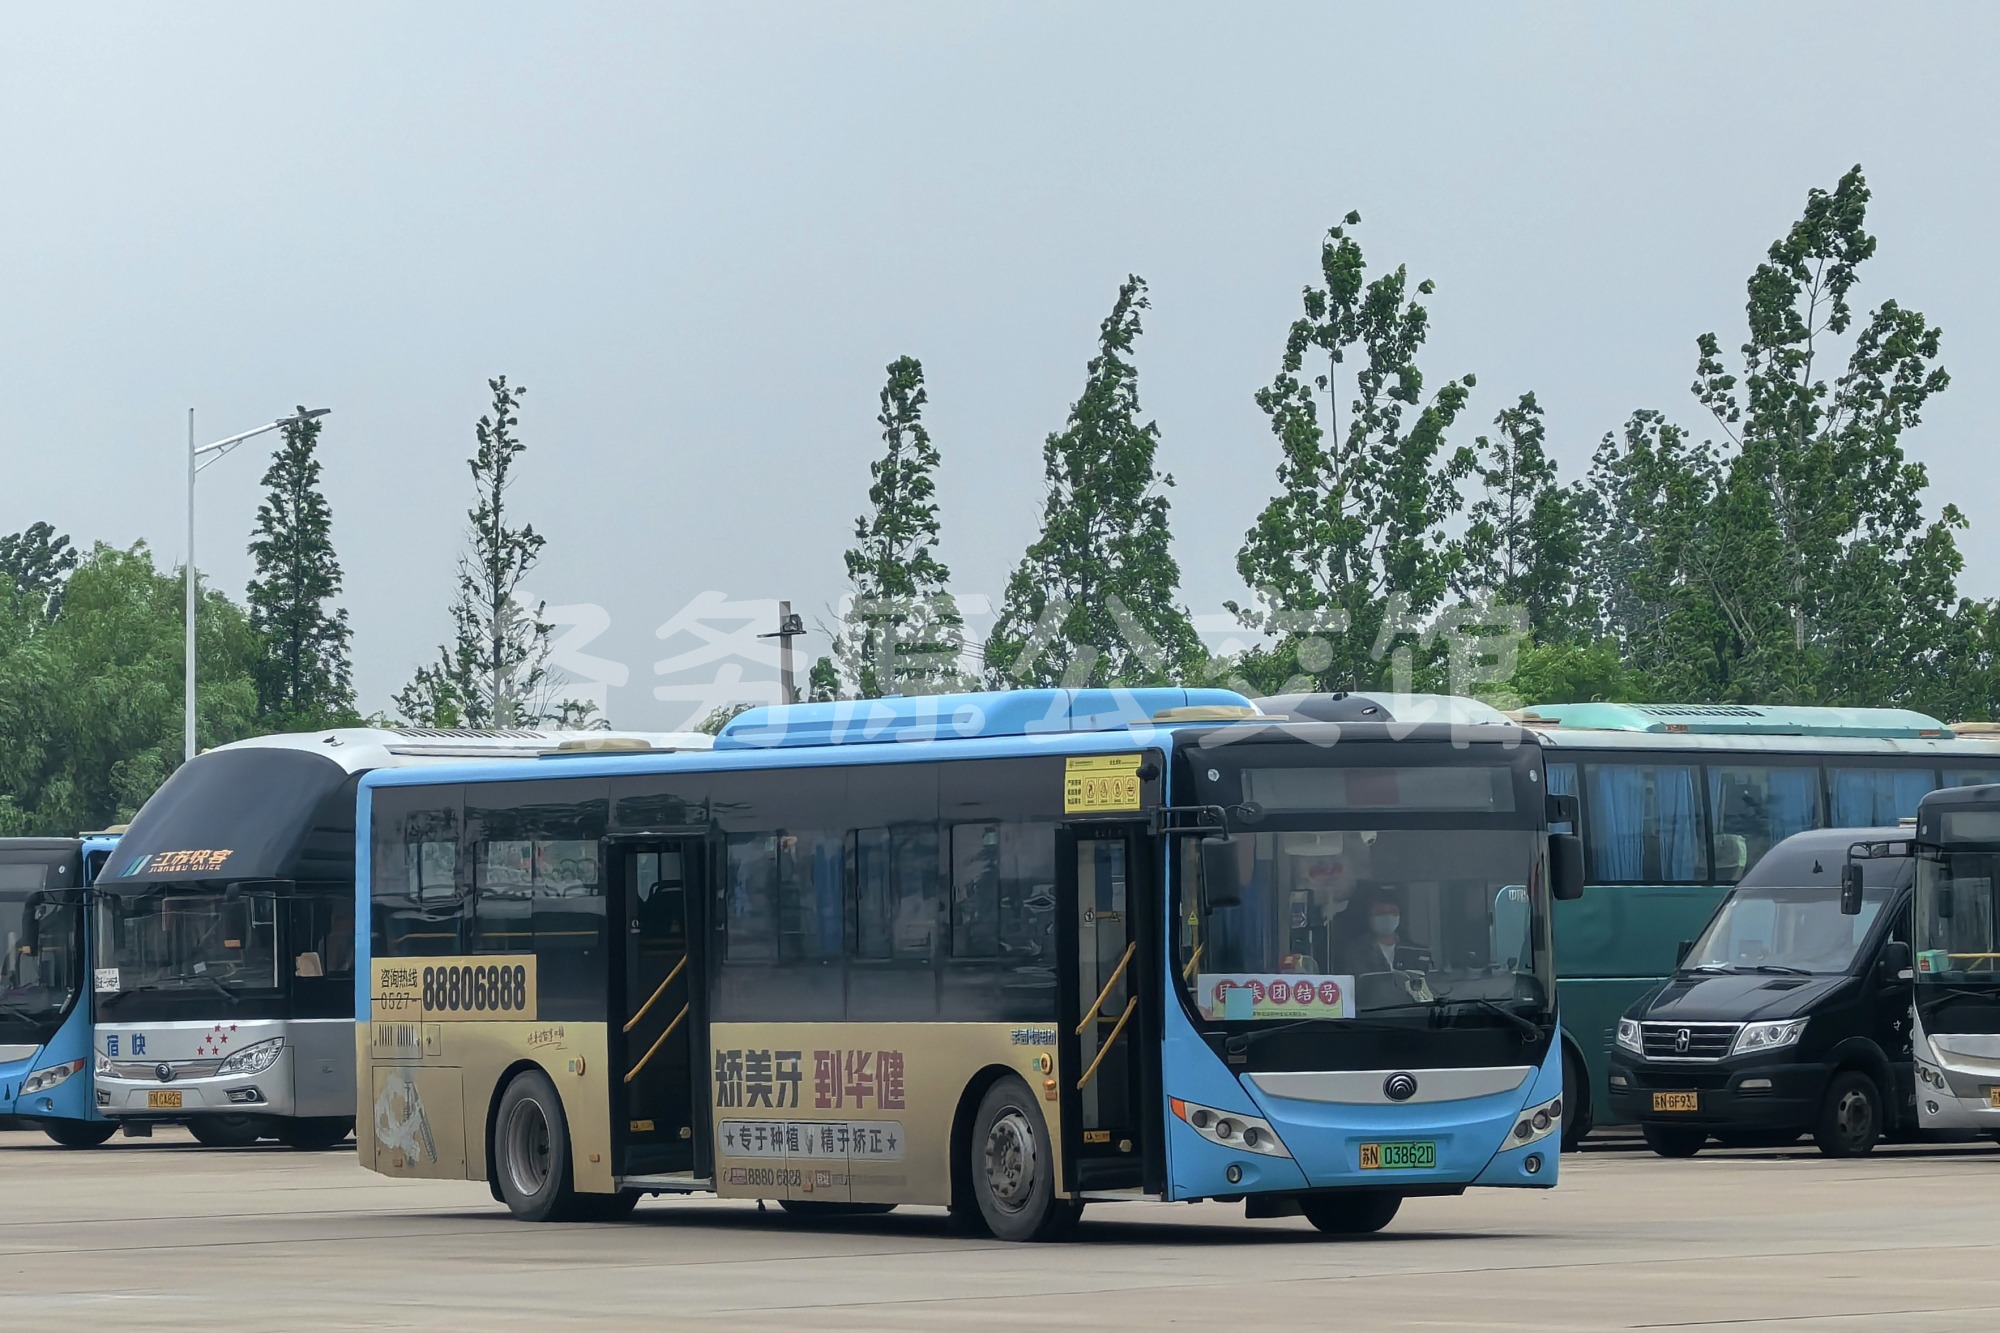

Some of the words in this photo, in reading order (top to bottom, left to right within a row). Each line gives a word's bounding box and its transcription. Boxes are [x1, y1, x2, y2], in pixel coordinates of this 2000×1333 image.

[381, 968, 418, 989] 咨询热线
[422, 964, 526, 1012] 88806888
[814, 1050, 906, 1109] 到华健
[739, 1125, 800, 1153] 专于种植
[821, 1126, 883, 1154] 精于矫正
